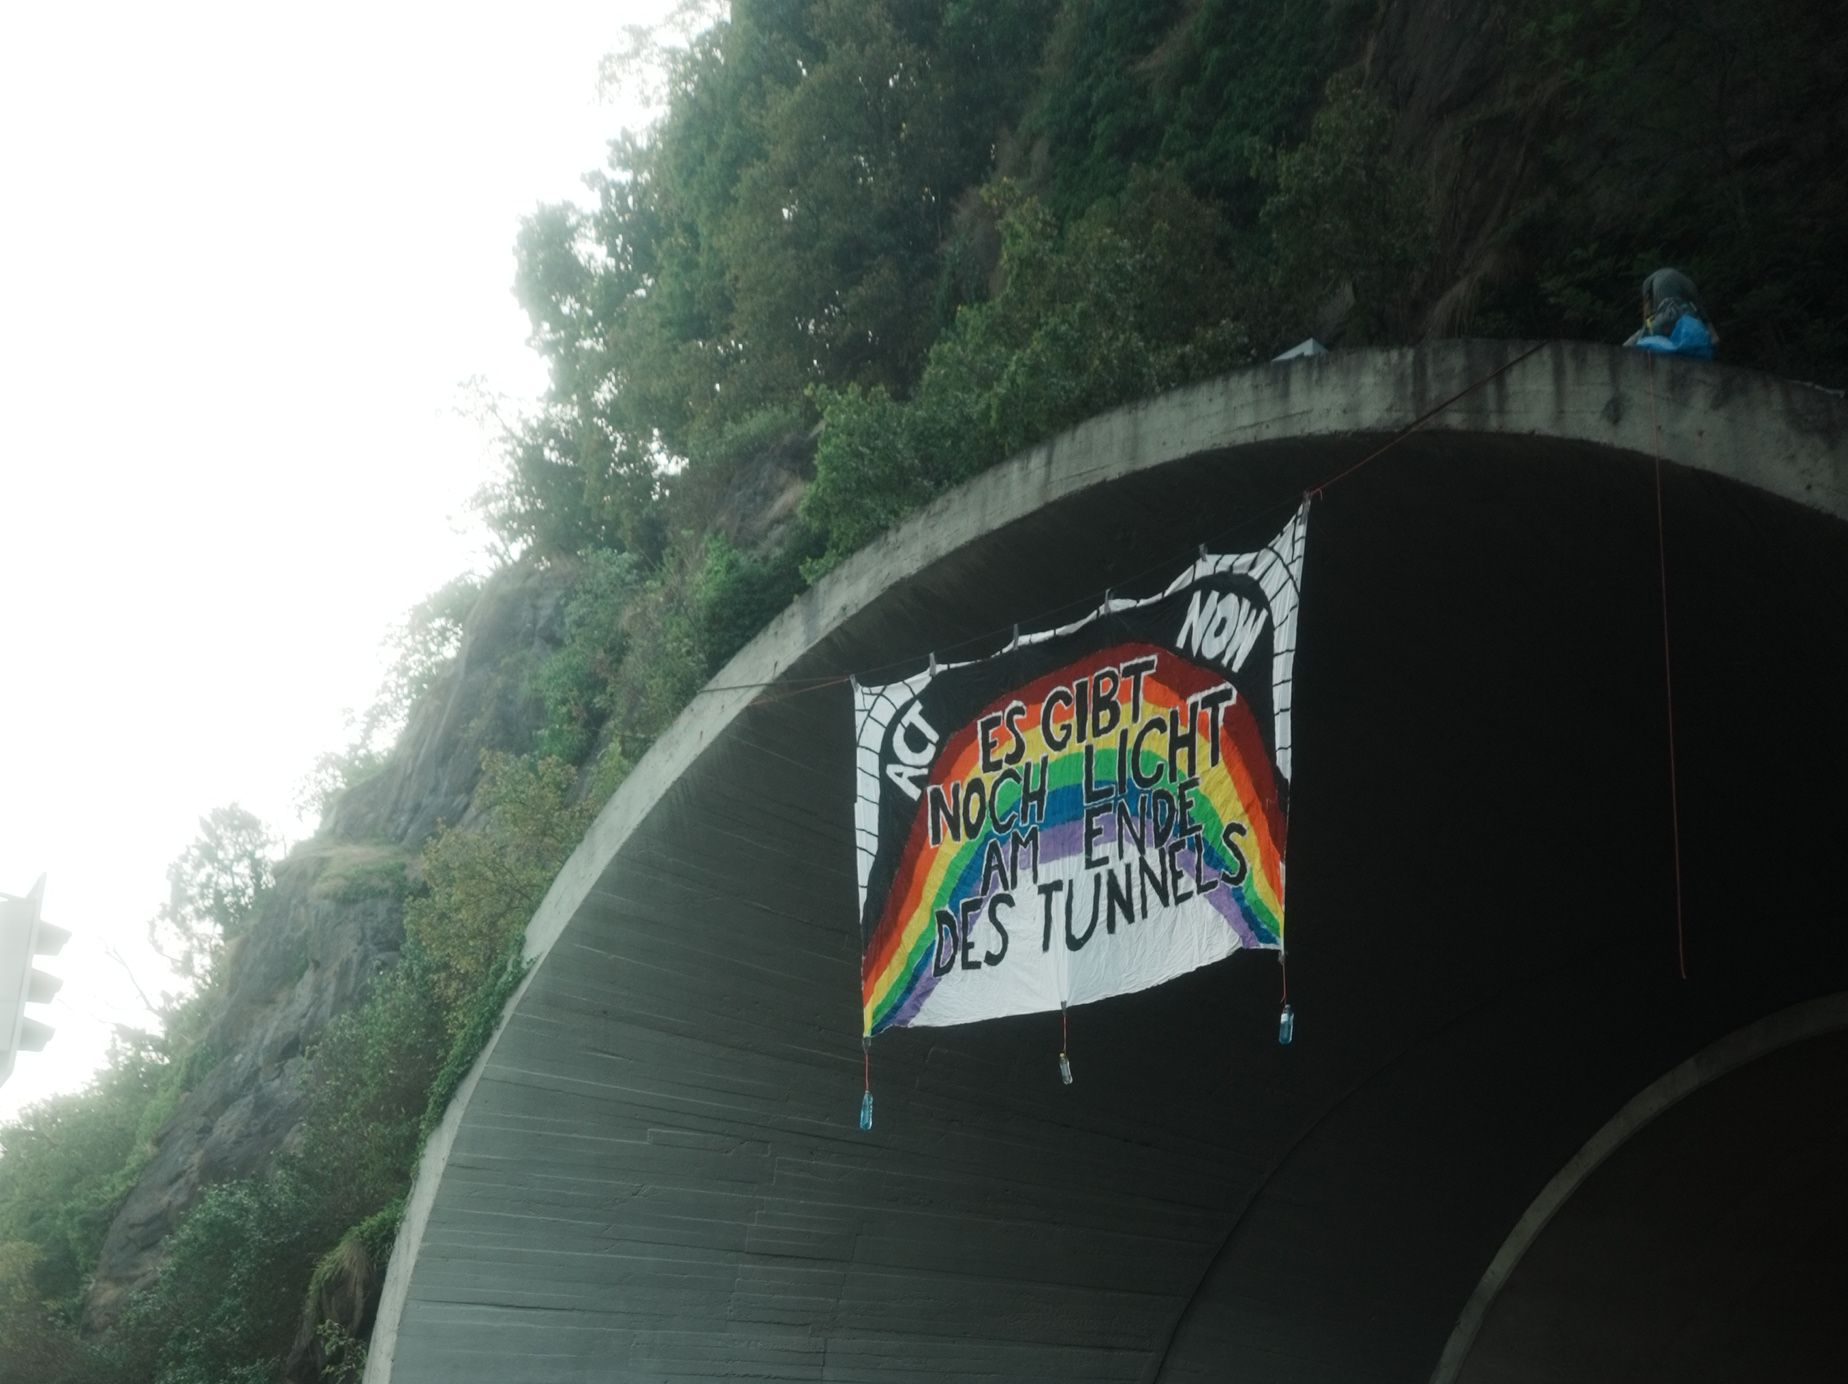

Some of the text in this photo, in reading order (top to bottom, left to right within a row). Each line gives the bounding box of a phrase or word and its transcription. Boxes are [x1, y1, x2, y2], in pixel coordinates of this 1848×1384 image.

[1176, 590, 1270, 674] NOW
[886, 700, 940, 802] ACT
[927, 682, 1238, 848] NOCH LICHT
[977, 655, 1158, 774] ES GIBT
[980, 777, 1204, 898] AM ENDE
[932, 822, 1249, 978] DES TUNNELS
